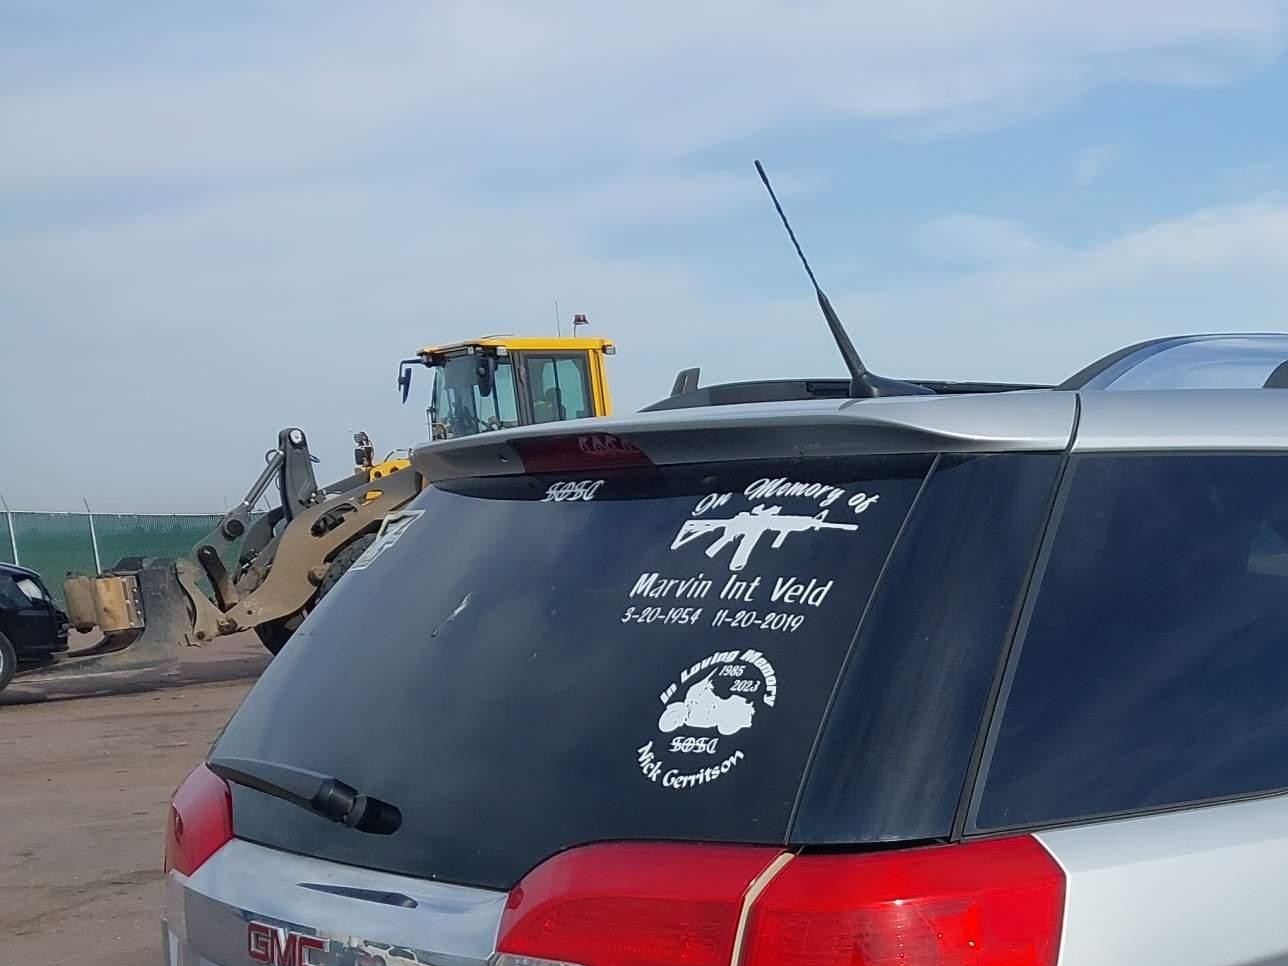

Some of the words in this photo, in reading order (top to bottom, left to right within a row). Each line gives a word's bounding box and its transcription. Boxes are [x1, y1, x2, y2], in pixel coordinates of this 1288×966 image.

[692, 492, 732, 516] In
[744, 477, 845, 507] Memory
[629, 573, 712, 599] Marvin
[719, 574, 762, 602] Int
[770, 577, 833, 606] Veld
[621, 606, 703, 625] 3-20-1954
[711, 609, 805, 632] 11-20-2019
[660, 683, 677, 704] In
[681, 650, 741, 683] Loving
[739, 649, 777, 707] Memory
[718, 665, 746, 676] 1985
[729, 680, 760, 692] 2023
[637, 740, 663, 782] Nick
[662, 750, 744, 789] Gerritson
